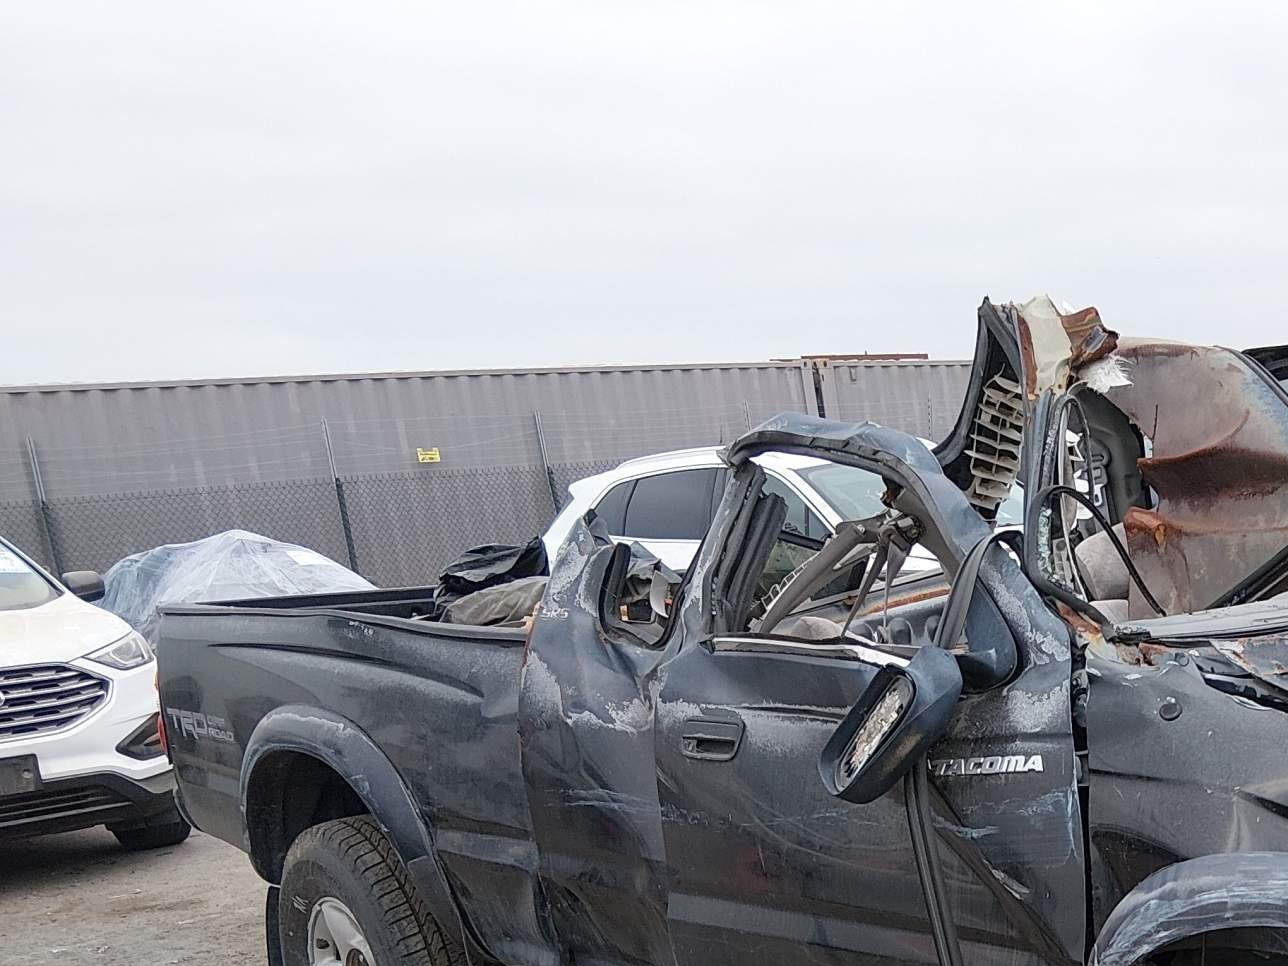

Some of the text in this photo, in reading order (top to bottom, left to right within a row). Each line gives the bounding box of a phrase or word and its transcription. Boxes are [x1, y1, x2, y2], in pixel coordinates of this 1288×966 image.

[166, 707, 207, 740] TRD
[207, 727, 236, 742] ROAD
[930, 754, 1044, 776] TACOMA
